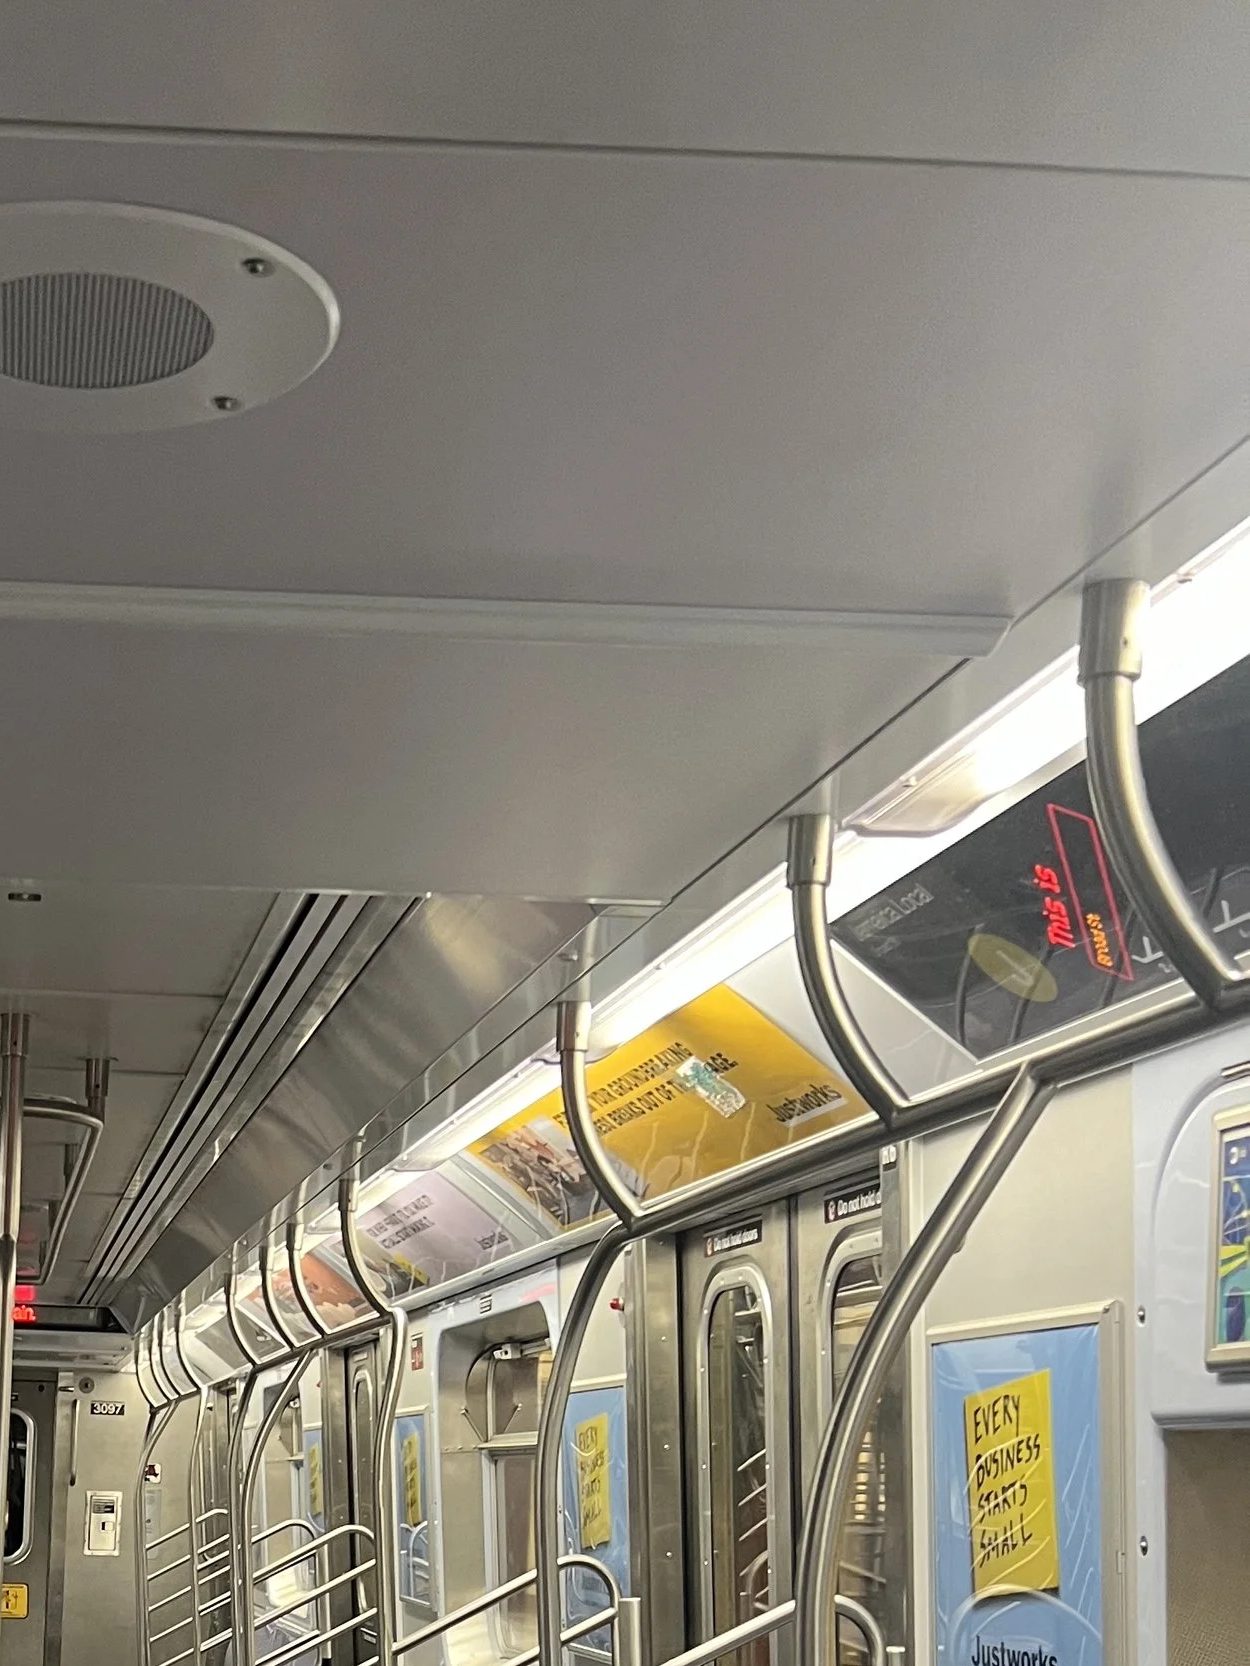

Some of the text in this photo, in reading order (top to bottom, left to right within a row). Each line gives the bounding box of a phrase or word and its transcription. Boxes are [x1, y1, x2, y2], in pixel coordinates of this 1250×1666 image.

[1033, 864, 1076, 948] This is
[636, 1090, 664, 1112] OUT
[766, 1083, 842, 1122] Justworks
[837, 1199, 848, 1216] Do
[848, 1194, 860, 1213] not
[93, 1403, 124, 1415] 3097
[973, 1394, 1021, 1445] EVERY
[976, 1433, 1041, 1492] BUSINESS
[978, 1472, 1028, 1524] STARTS
[979, 1512, 1034, 1568] SMALL
